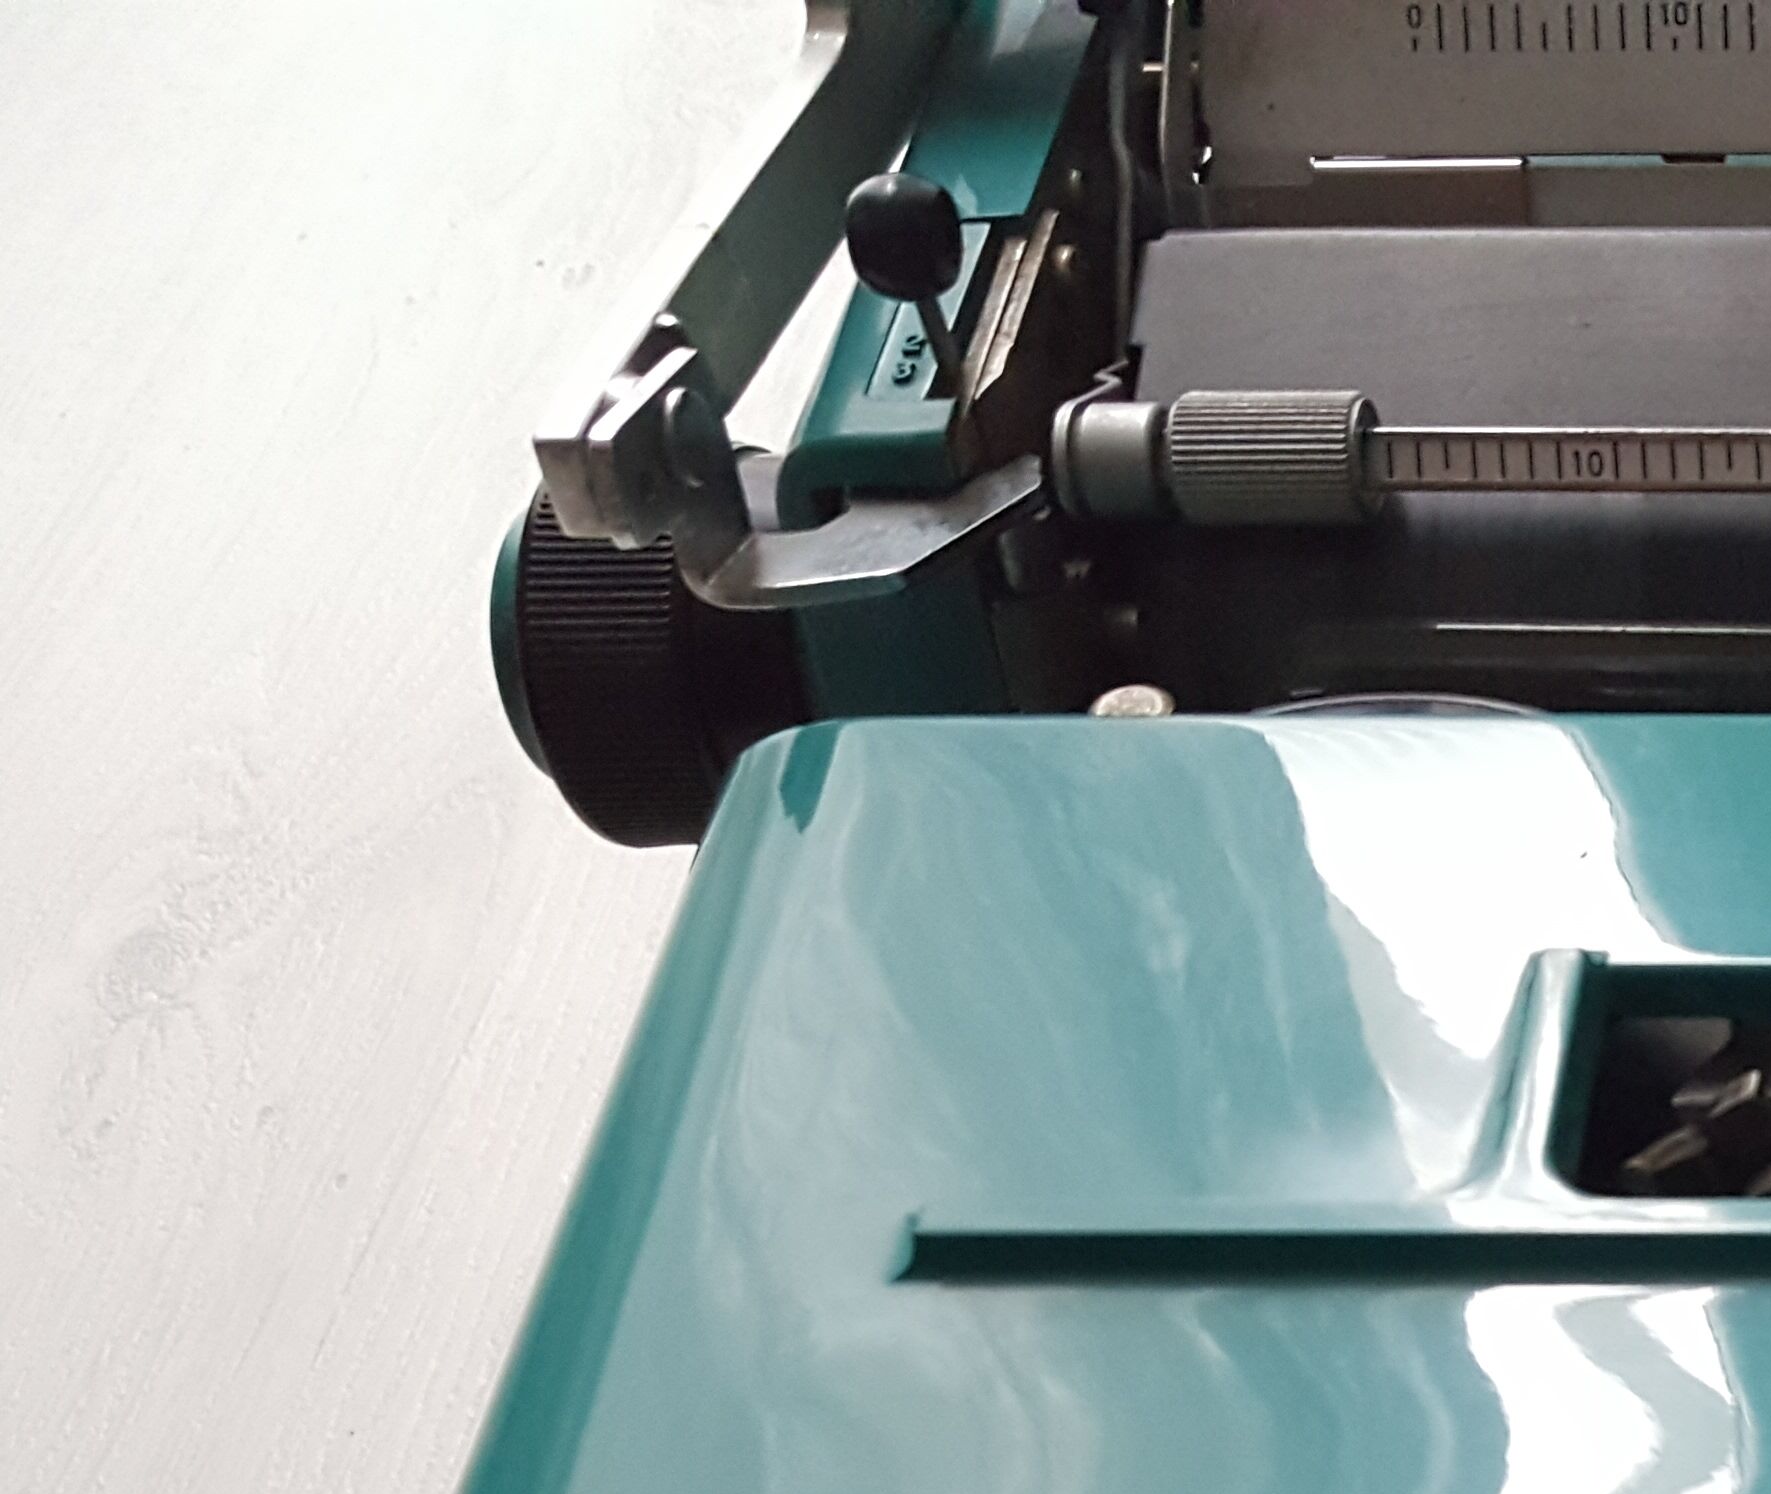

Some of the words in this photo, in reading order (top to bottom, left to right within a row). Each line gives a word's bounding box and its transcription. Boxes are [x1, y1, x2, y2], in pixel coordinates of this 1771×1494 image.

[1406, 4, 1423, 29] 0
[1661, 3, 1692, 27] 10
[1571, 449, 1607, 480] 10
